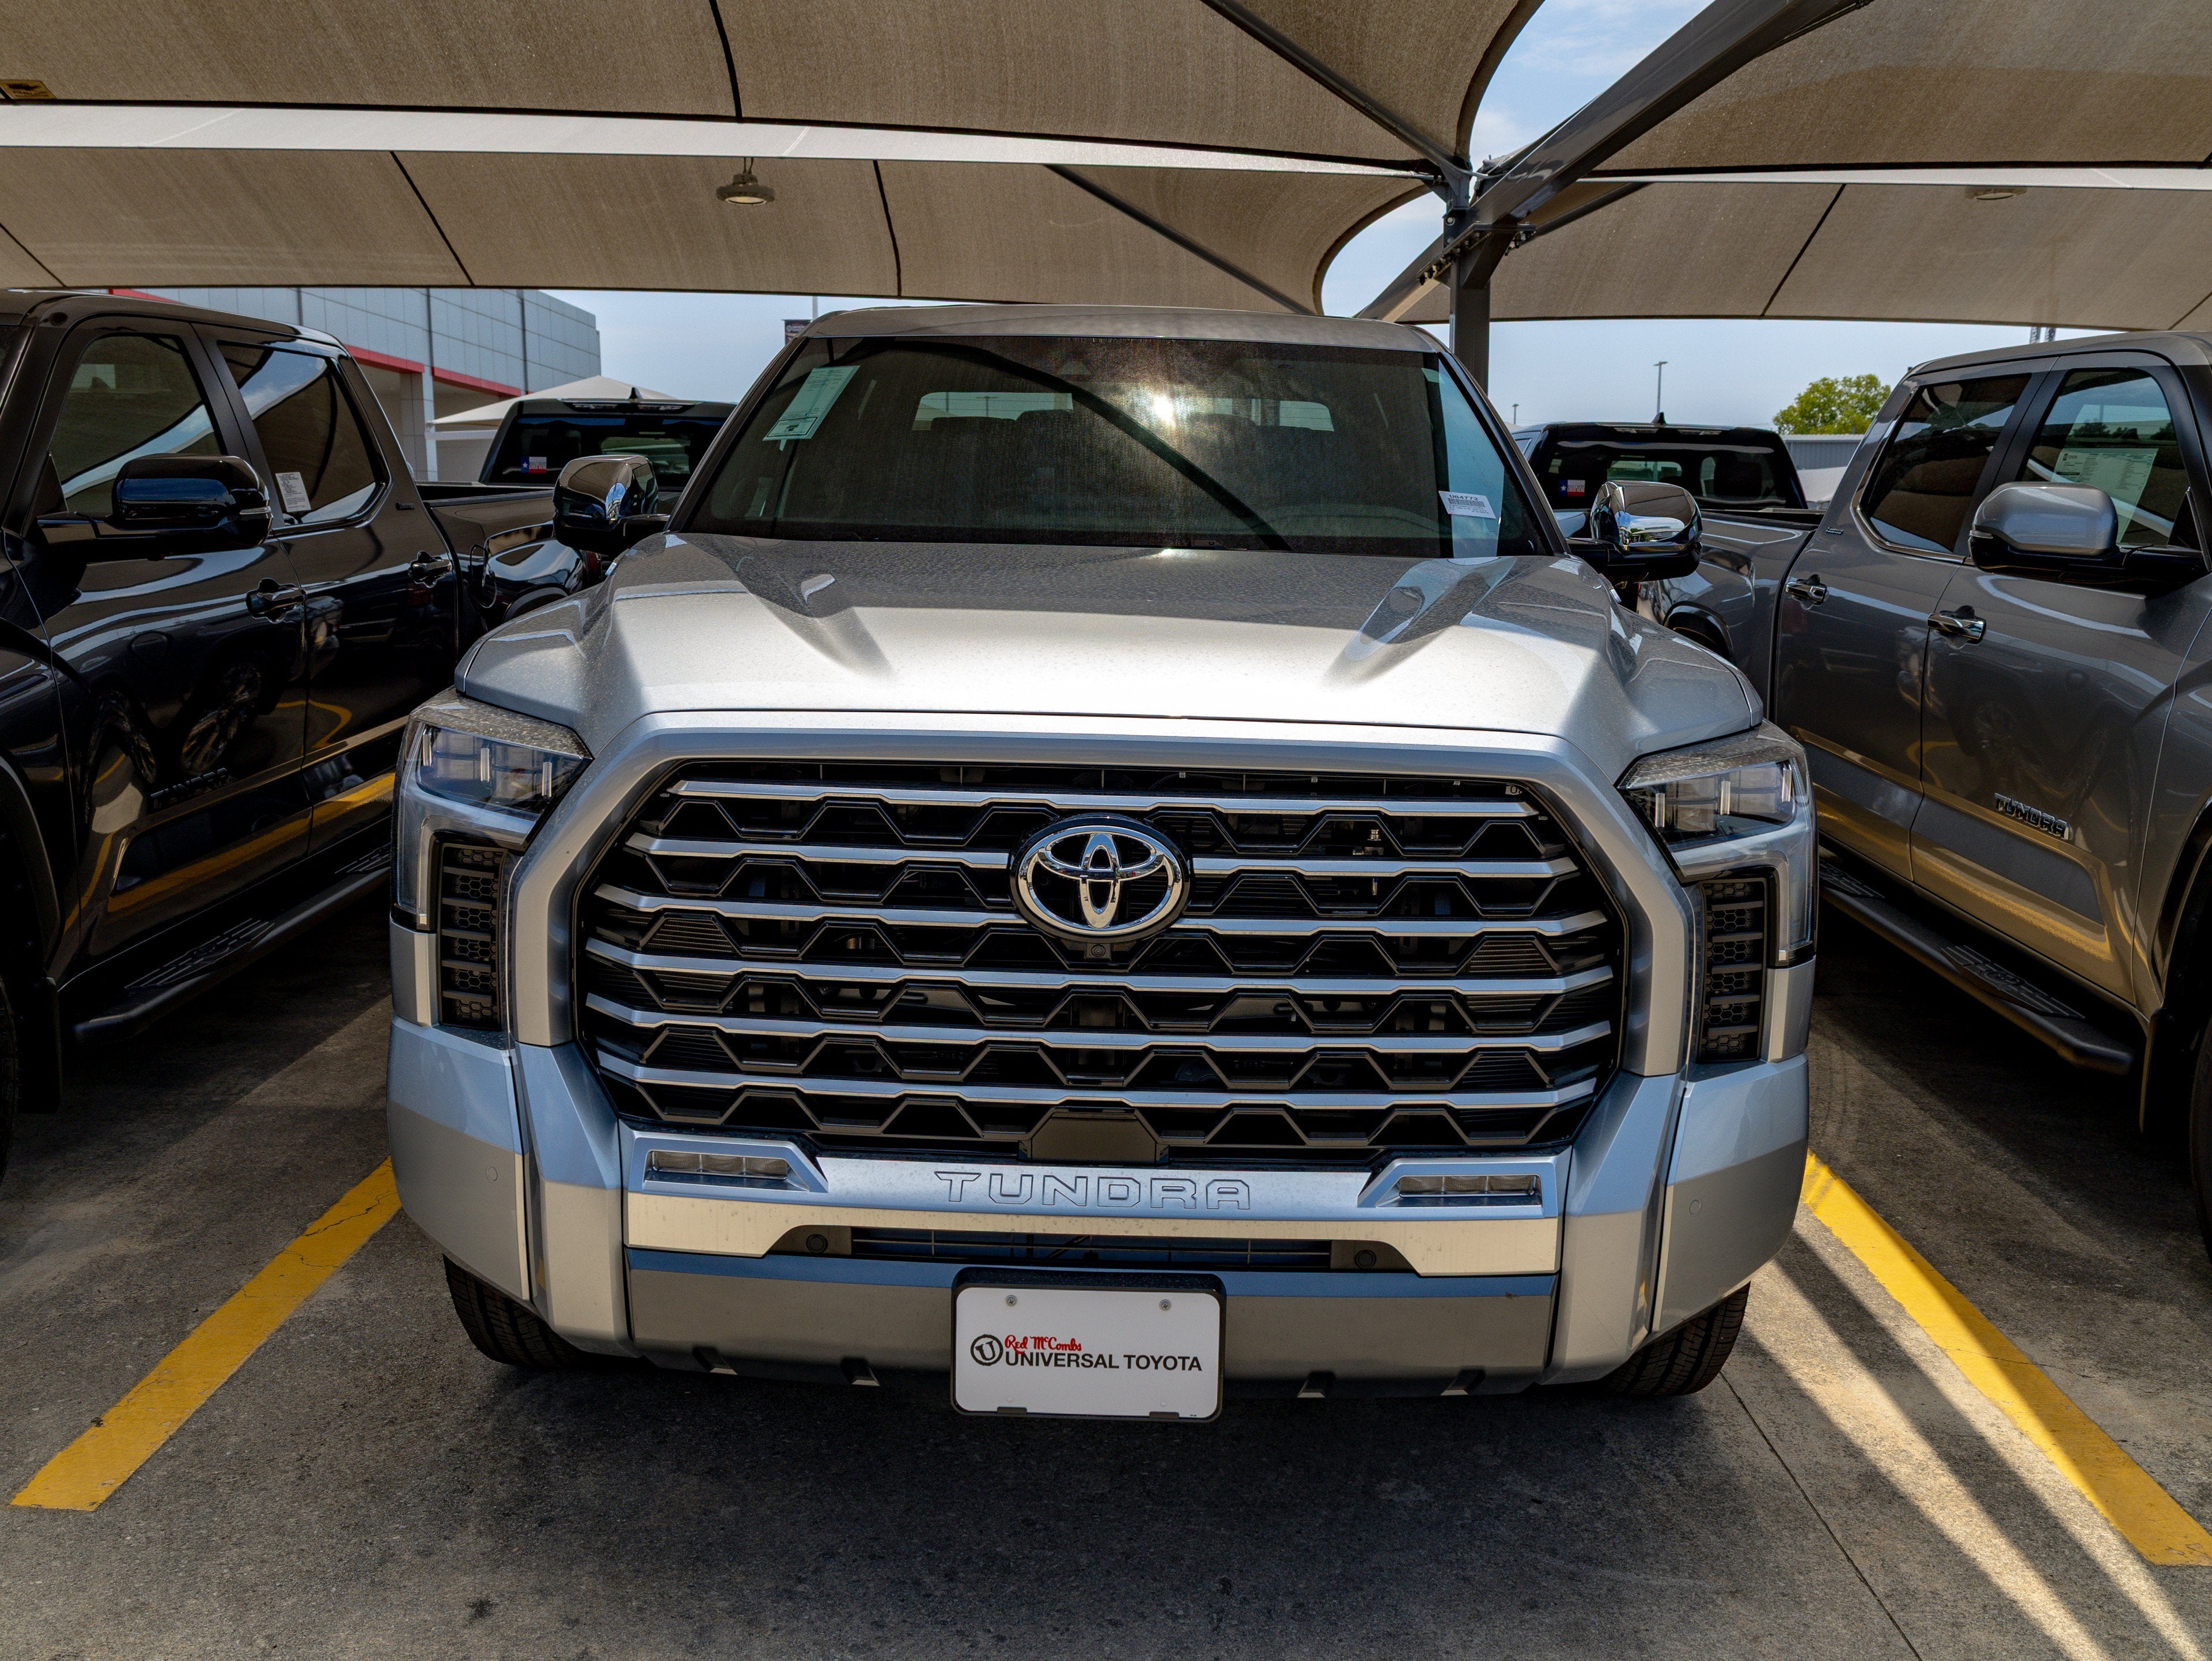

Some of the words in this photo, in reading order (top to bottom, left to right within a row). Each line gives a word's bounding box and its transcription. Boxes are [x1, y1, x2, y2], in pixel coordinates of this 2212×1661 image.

[1995, 793, 2073, 840] TUNDRA
[934, 1171, 1251, 1210] TUNDRA
[1005, 1334, 1028, 1354] Red
[1029, 1335, 1082, 1352] McCombs
[1005, 1352, 1119, 1369] UNIVERSAL
[1123, 1354, 1203, 1372] TOYOTA
